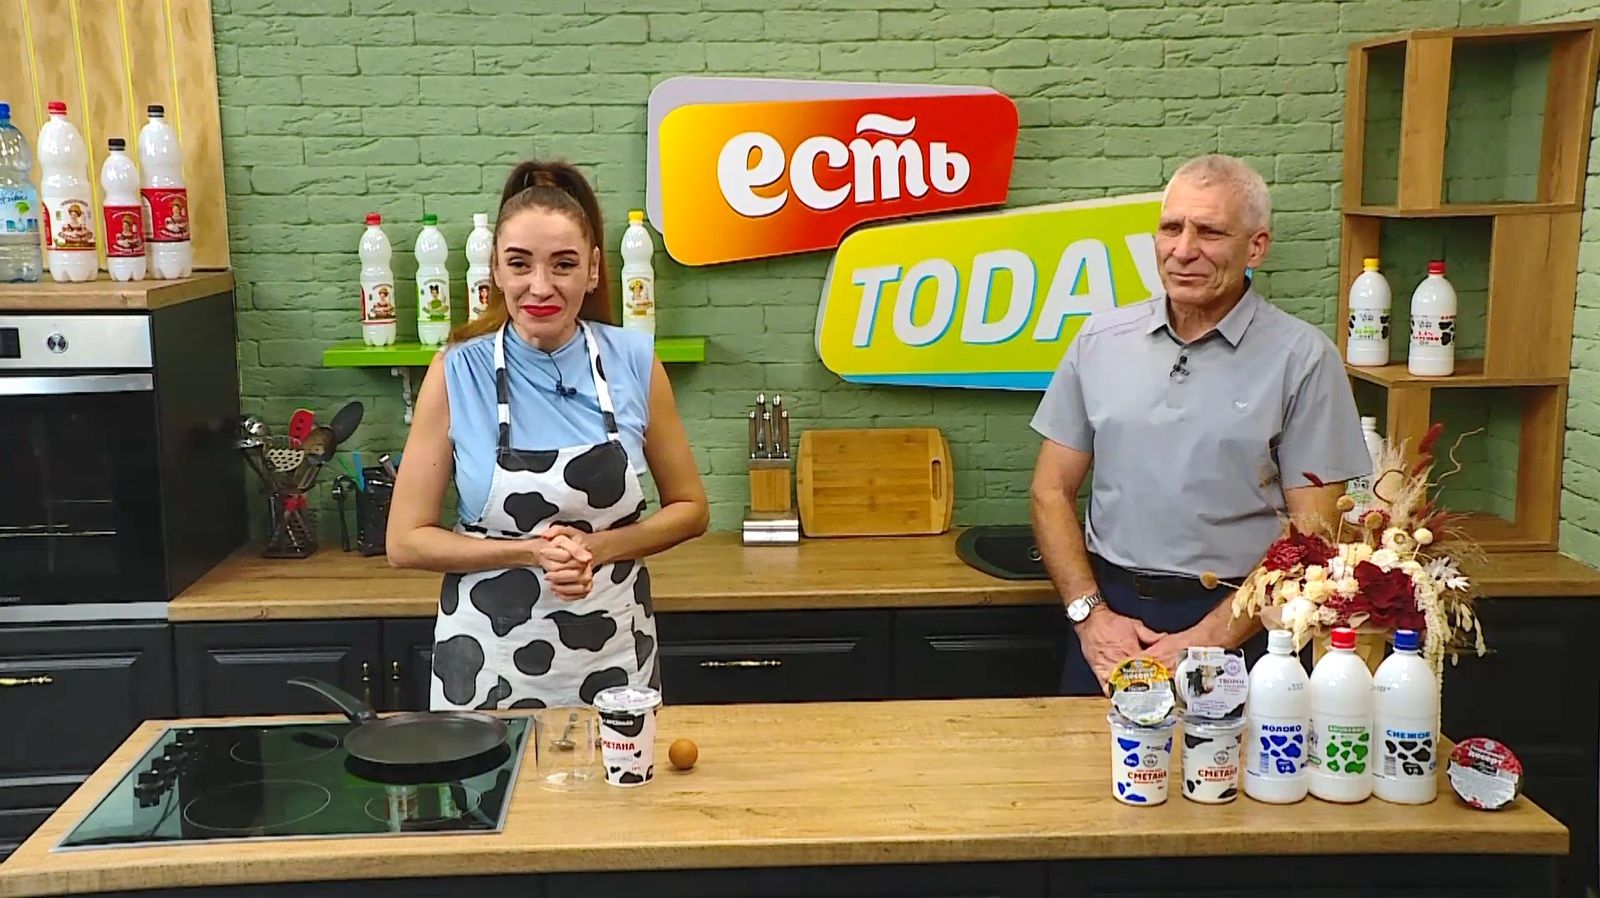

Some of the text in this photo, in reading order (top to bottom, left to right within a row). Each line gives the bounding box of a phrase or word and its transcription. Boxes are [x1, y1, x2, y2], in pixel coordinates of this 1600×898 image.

[717, 113, 970, 217] есть
[1386, 730, 1431, 740] СНЕЖОК
[602, 740, 635, 750] МЕТАНА
